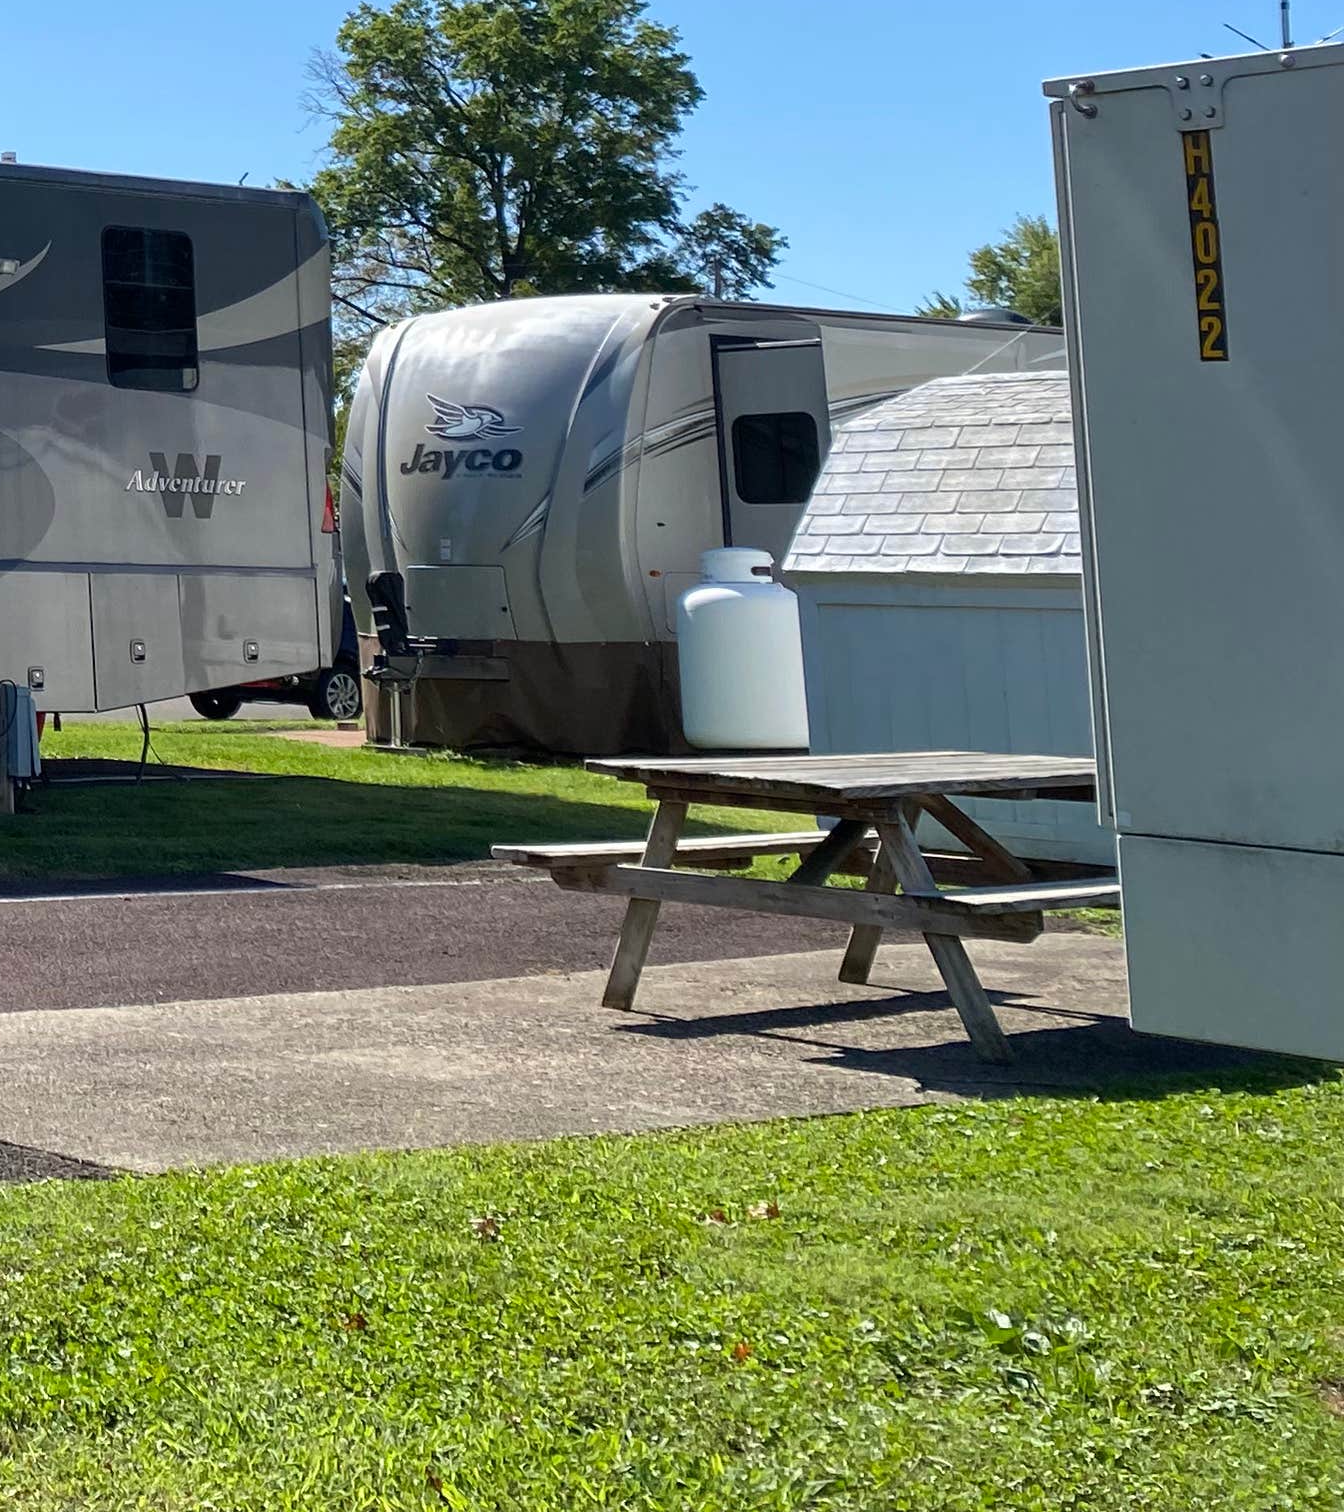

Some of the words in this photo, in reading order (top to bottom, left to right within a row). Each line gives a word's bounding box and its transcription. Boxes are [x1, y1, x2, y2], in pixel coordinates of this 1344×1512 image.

[1184, 133, 1224, 358] H40022
[400, 443, 523, 480] Jayco
[126, 470, 247, 496] Adventurer
